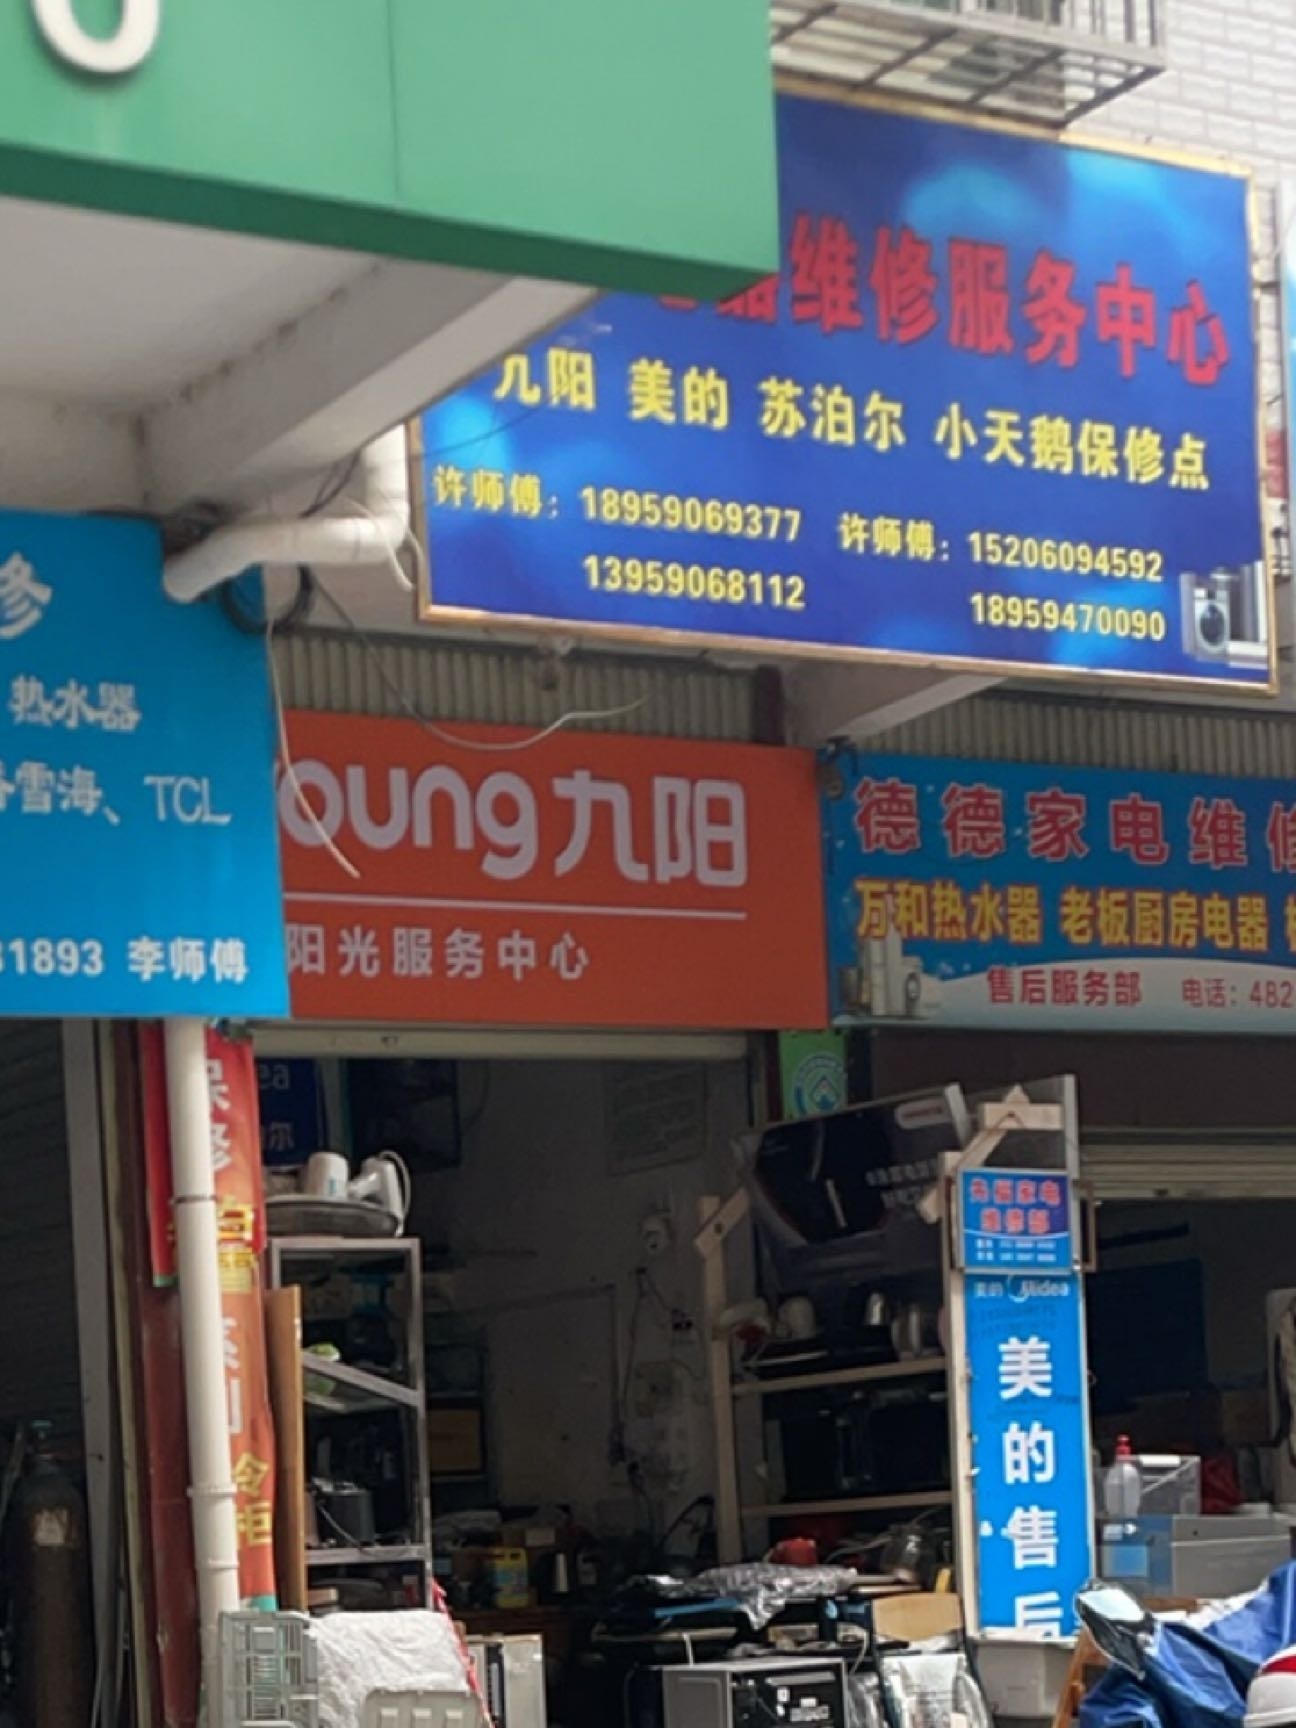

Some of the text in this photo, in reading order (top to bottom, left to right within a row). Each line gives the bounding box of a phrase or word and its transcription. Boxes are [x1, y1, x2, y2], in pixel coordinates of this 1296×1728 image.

[659, 213, 1231, 386] 维修服务中心
[493, 347, 1210, 490] 九阳 美的 苏泊尔 小天鹅保修点
[582, 555, 1167, 641] 13959068112 18959470090
[854, 875, 1041, 945] 万和热水器
[1059, 885, 1269, 952] 老板厨房电器
[128, 936, 249, 984] 李师傅
[285, 924, 590, 981] 阳光服务中心
[985, 967, 1143, 1009] 售后服务部
